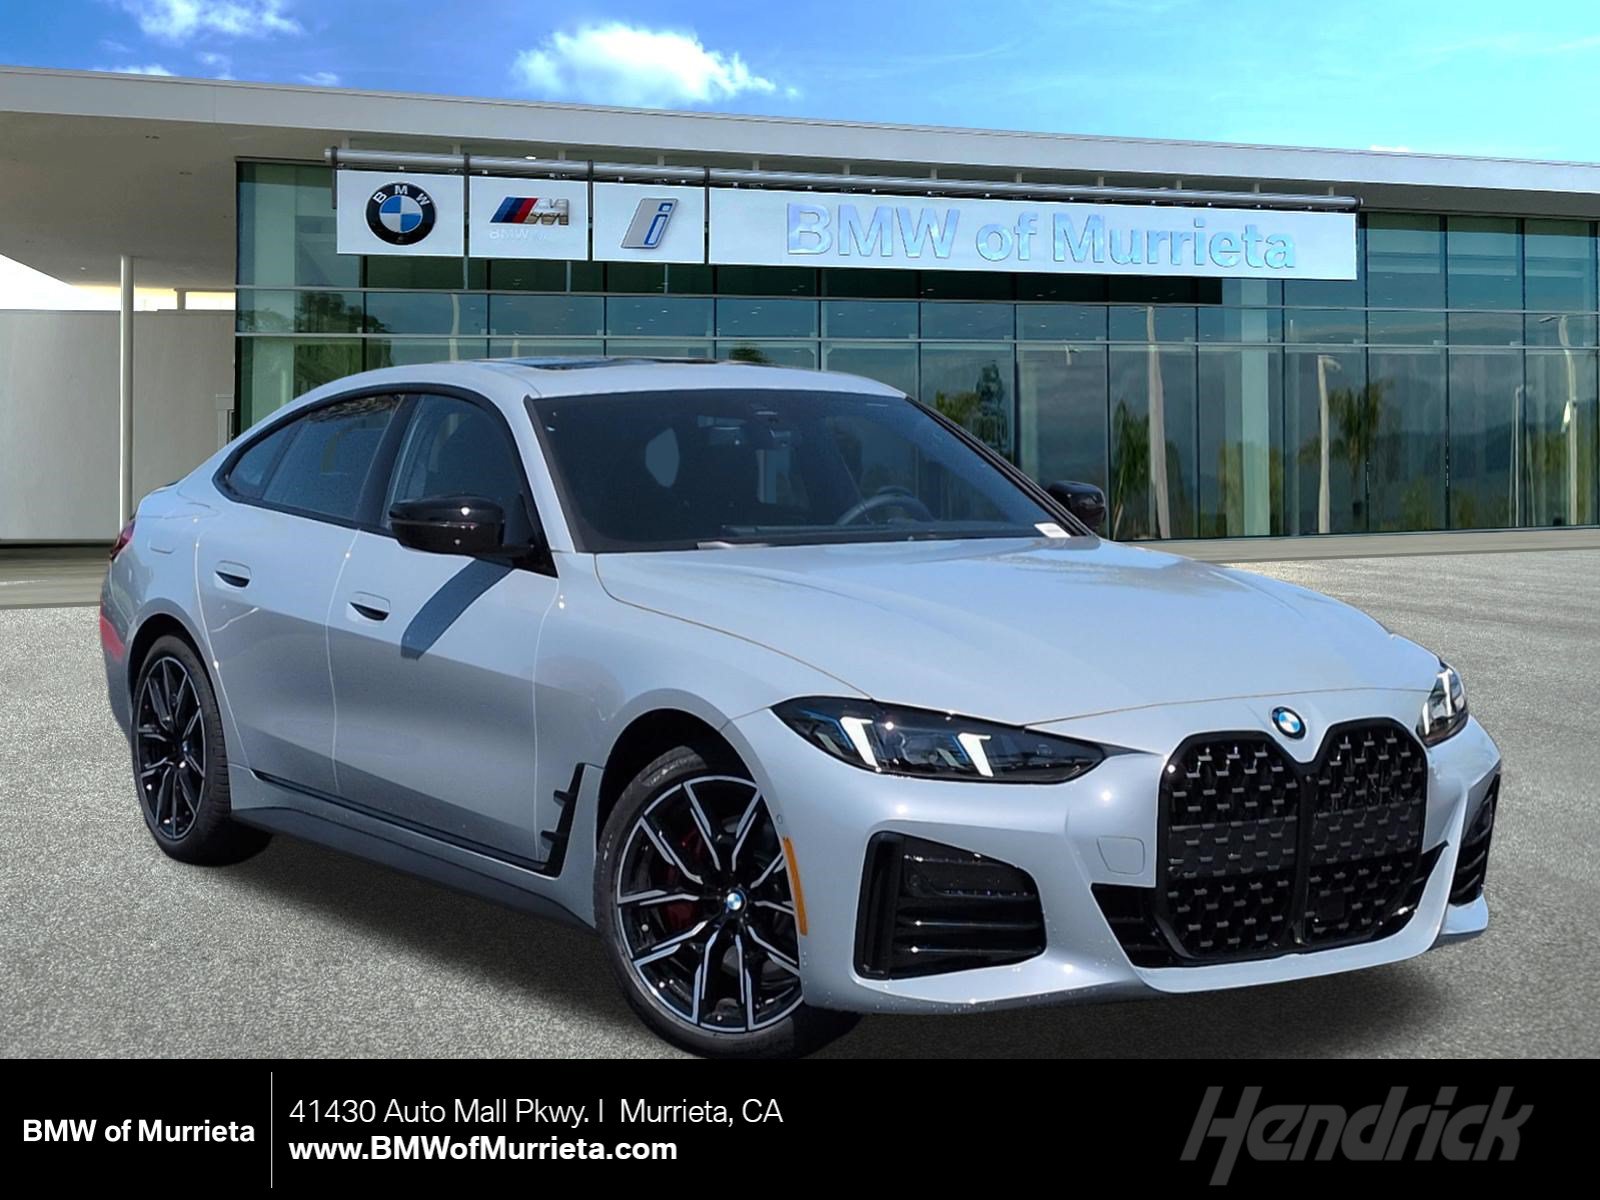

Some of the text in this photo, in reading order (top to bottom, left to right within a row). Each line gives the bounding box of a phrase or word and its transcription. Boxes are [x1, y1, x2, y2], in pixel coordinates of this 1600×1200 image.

[372, 184, 431, 206] BMW
[786, 202, 1297, 270] BMW of Murrieta
